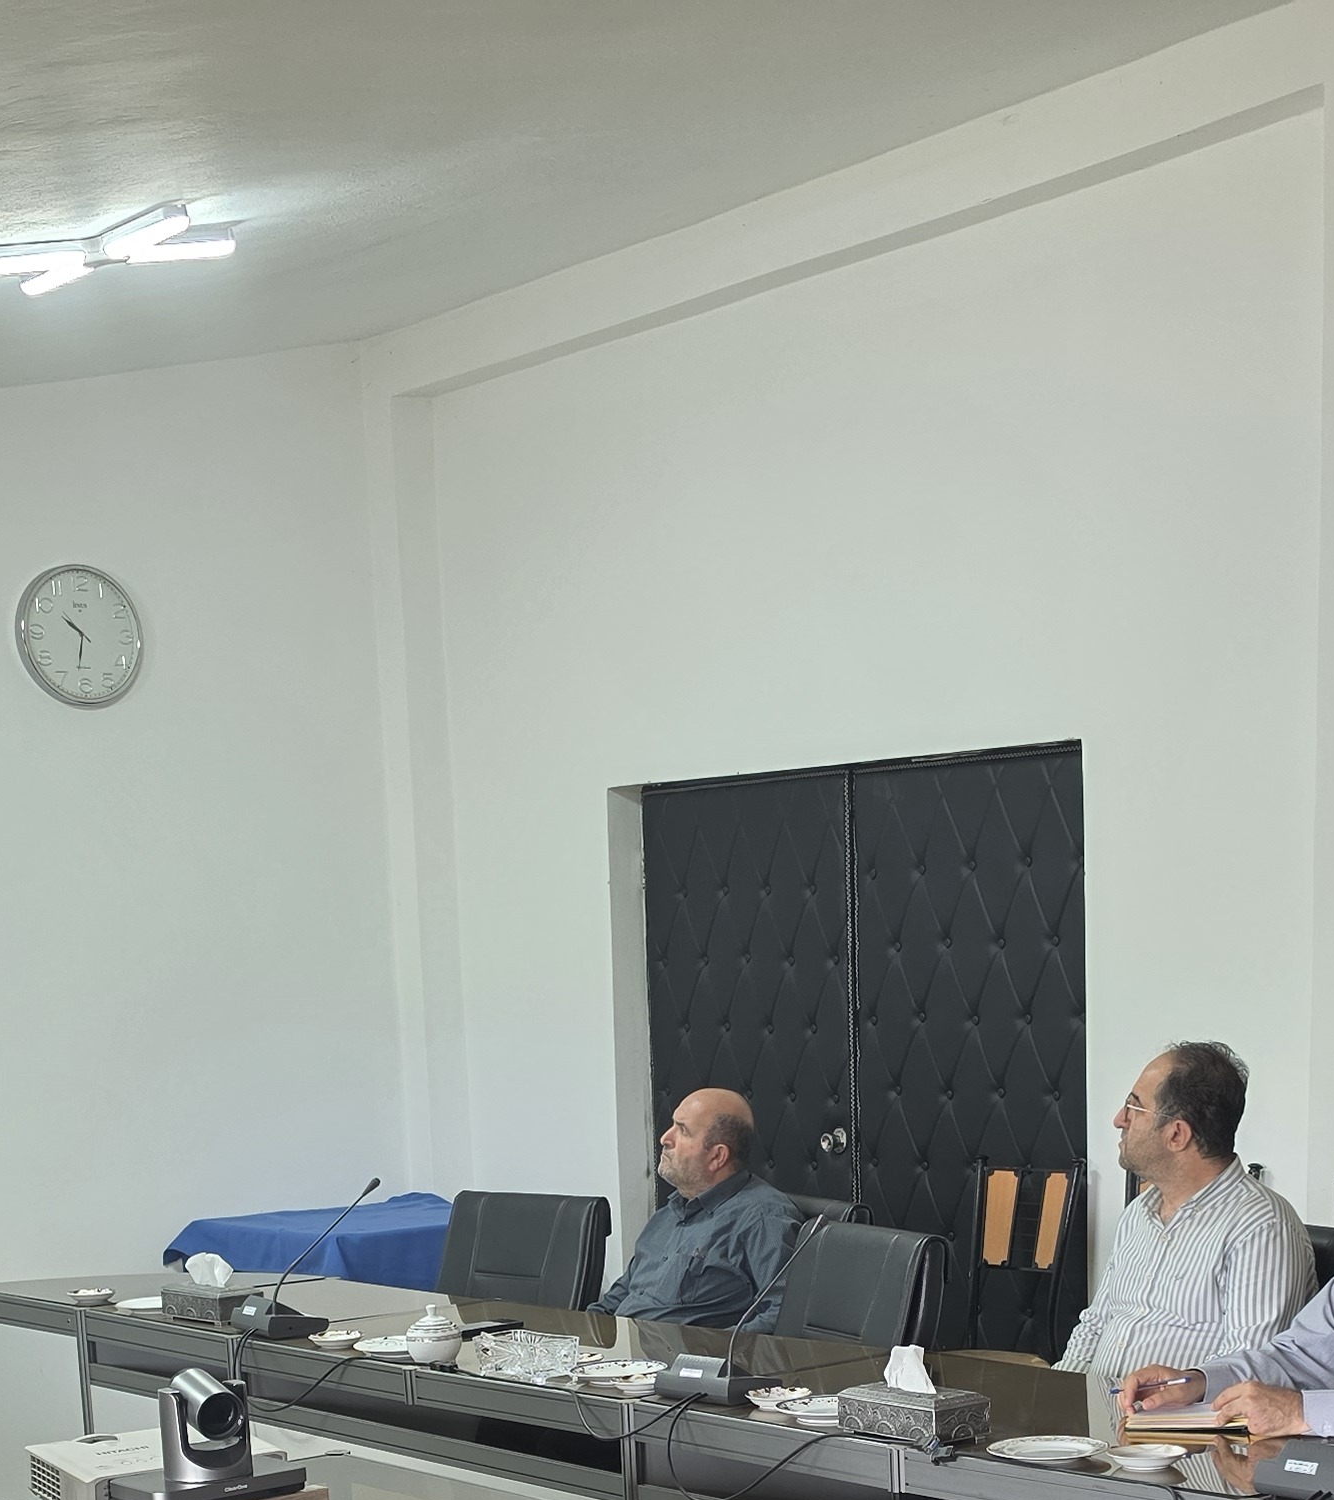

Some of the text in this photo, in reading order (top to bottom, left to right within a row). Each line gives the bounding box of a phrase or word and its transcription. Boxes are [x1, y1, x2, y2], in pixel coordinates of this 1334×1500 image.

[71, 576, 89, 592] 12
[35, 597, 54, 614] 10
[96, 1445, 149, 1456] HITACHI
